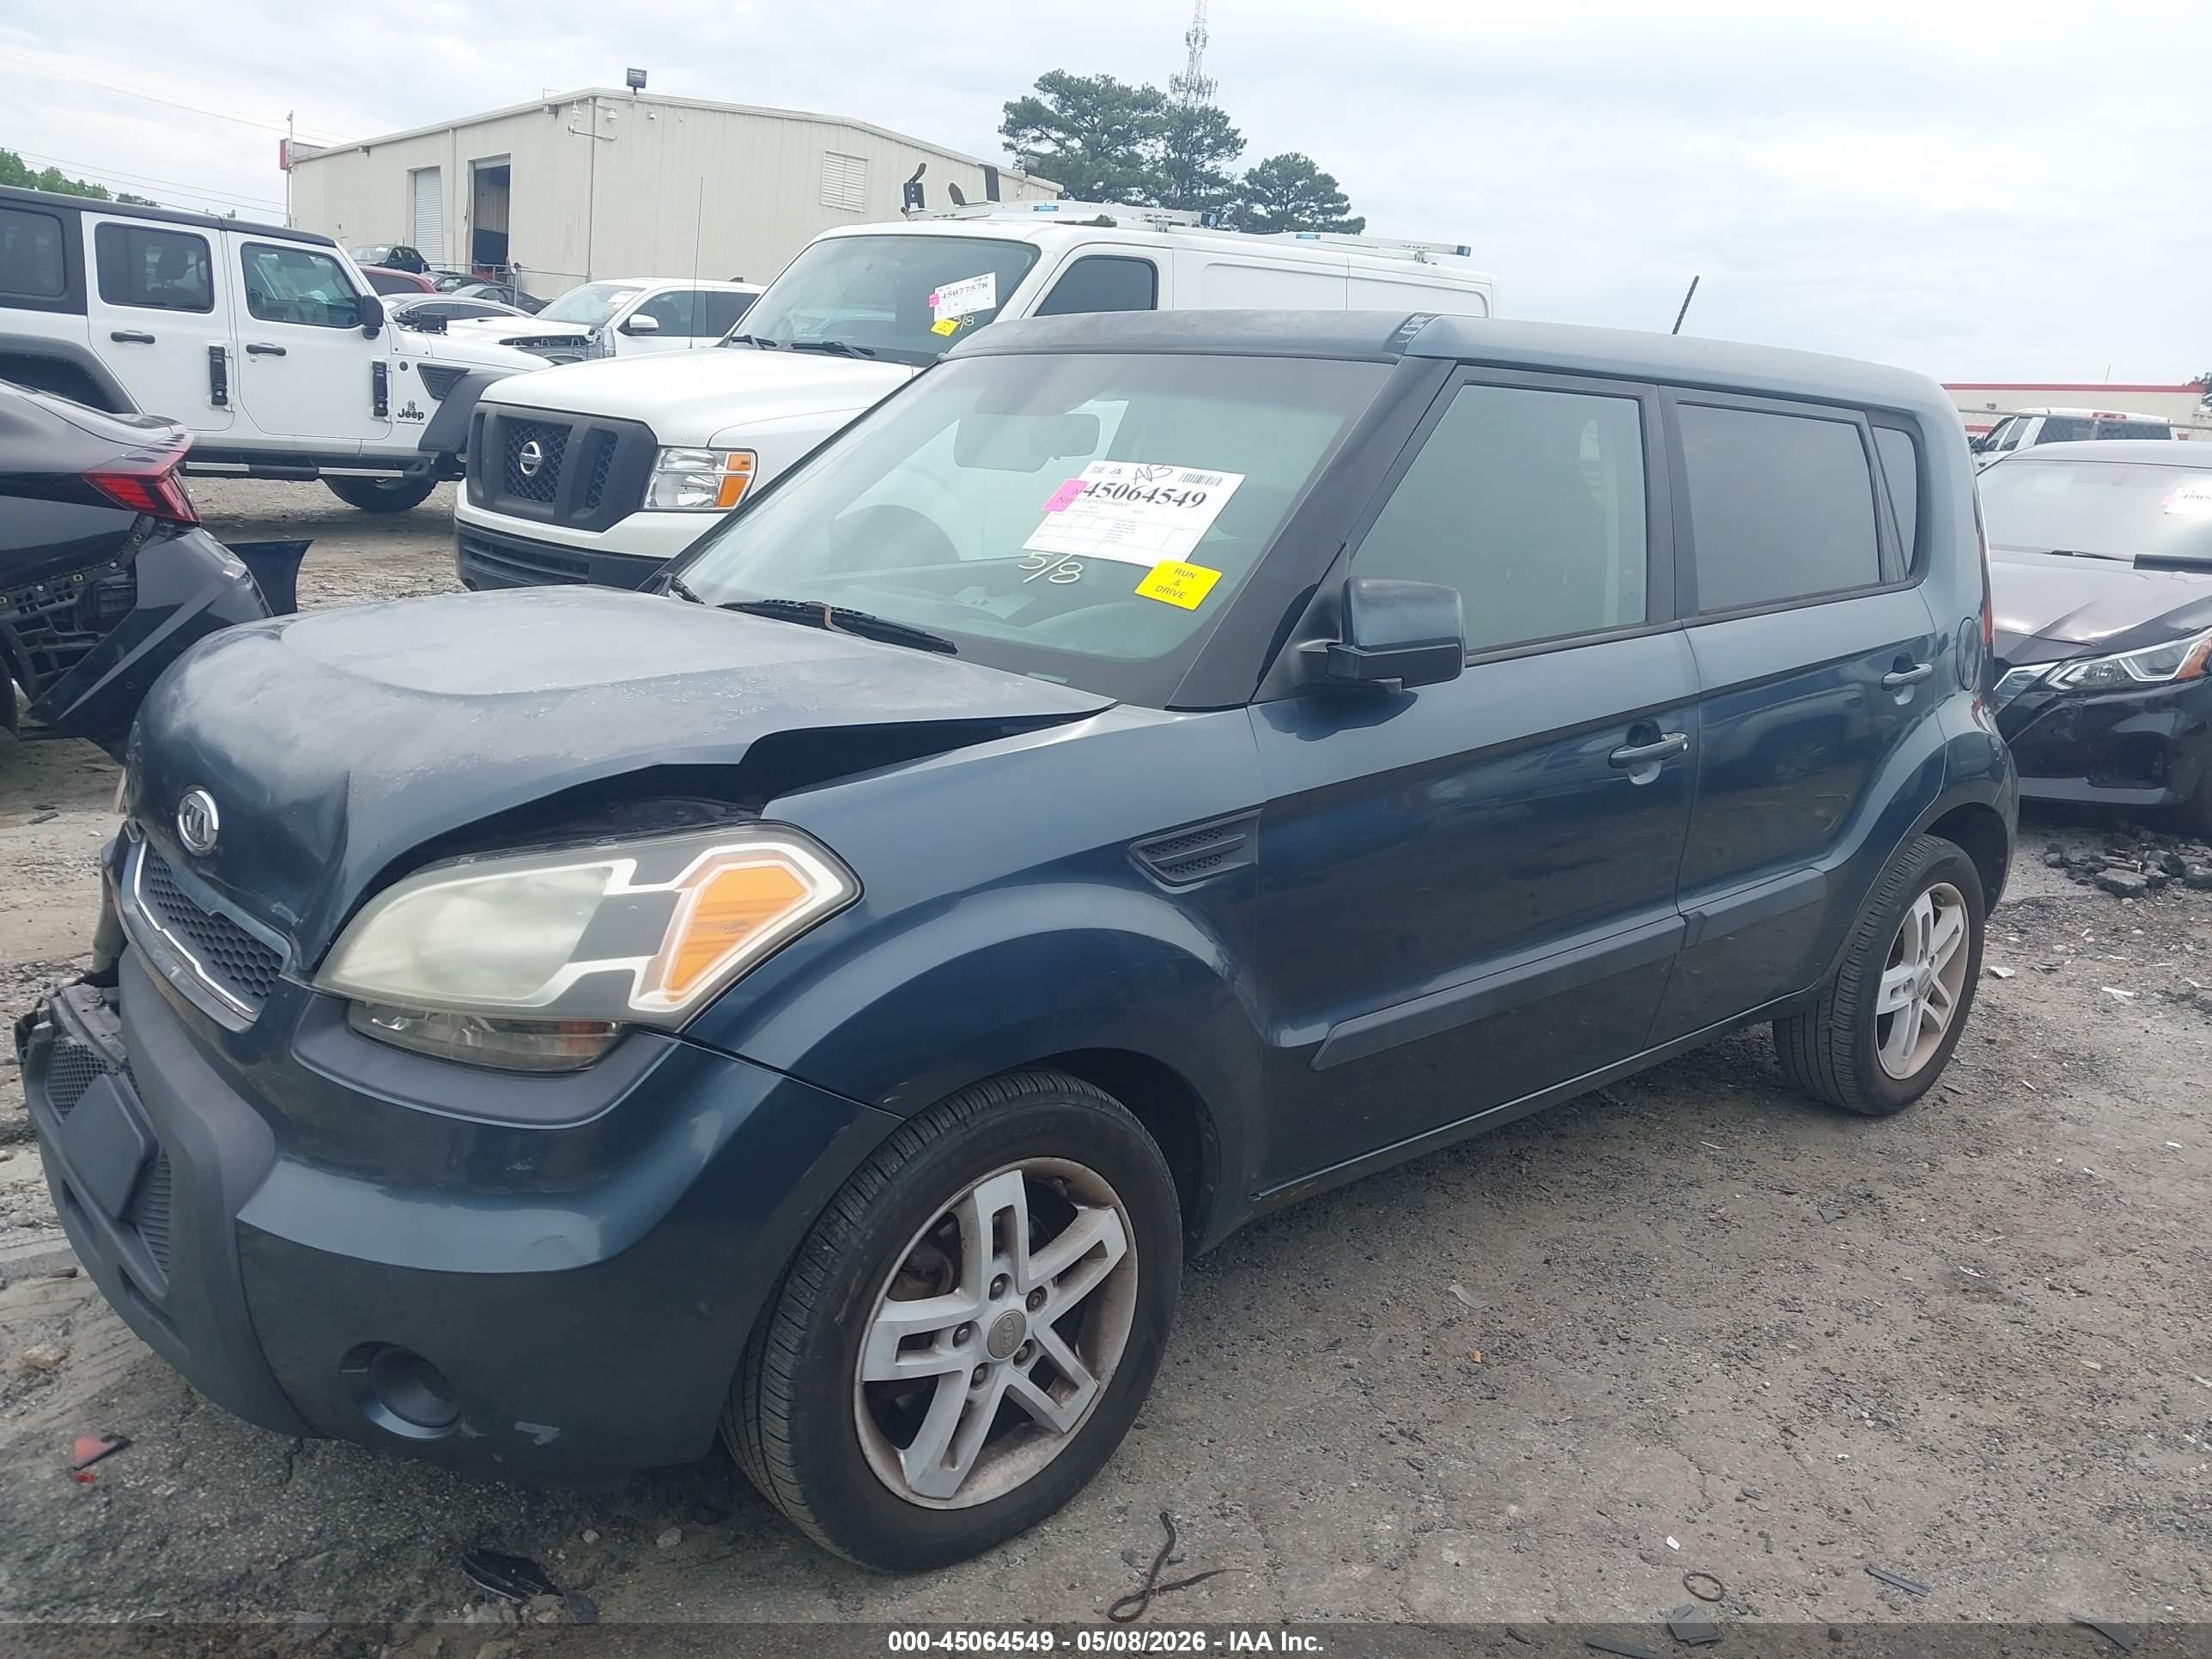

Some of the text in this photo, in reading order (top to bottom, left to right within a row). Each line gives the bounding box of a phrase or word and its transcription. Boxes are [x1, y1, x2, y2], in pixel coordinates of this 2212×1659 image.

[398, 408, 424, 421] Jeep
[1083, 481, 1207, 508] 45064549
[1018, 552, 1084, 584] 5/8
[1174, 568, 1197, 580] RUN
[1155, 585, 1187, 599] DRIVE
